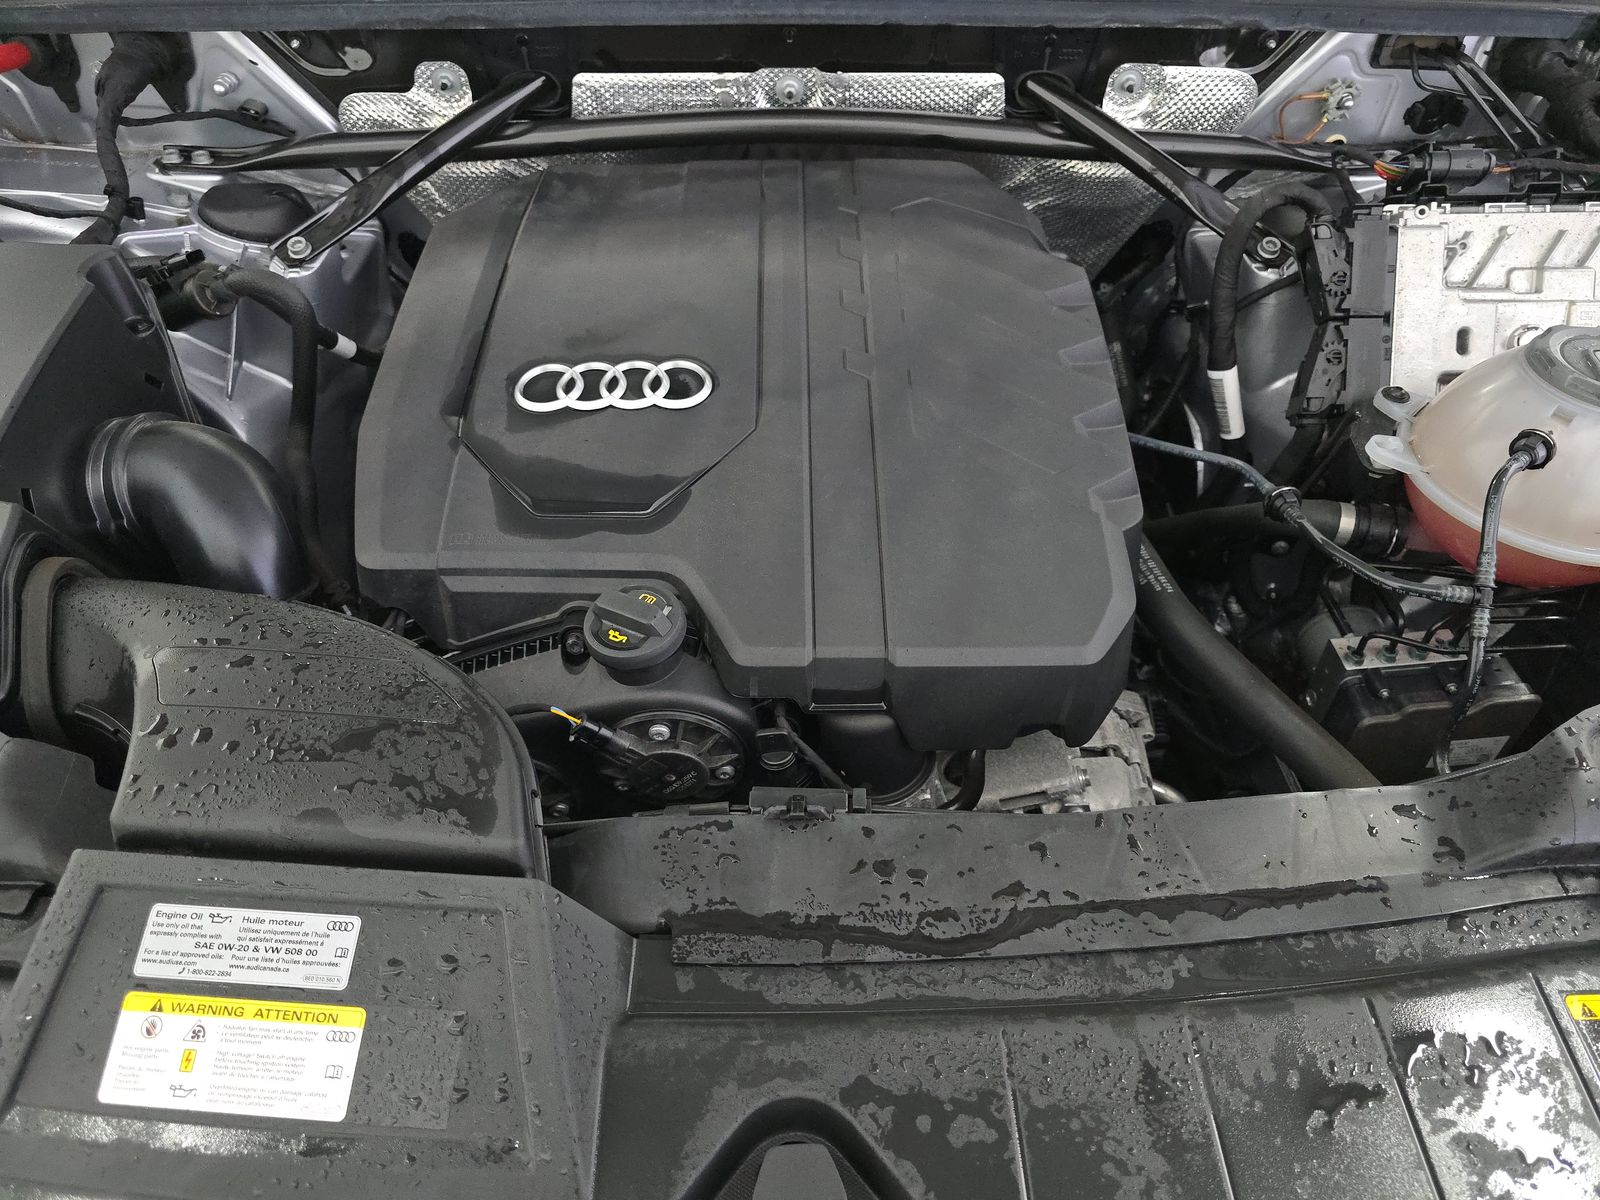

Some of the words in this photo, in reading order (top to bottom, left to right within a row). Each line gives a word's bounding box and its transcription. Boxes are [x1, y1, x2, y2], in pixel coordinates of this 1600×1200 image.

[156, 910, 187, 920] Engine
[242, 916, 266, 924] Huile
[268, 919, 304, 927] moteur
[194, 941, 215, 950] SAE
[217, 943, 250, 952] 0W-20
[265, 946, 283, 954] VW
[285, 947, 303, 956] 508
[180, 951, 210, 960] approved
[142, 958, 198, 966] www.audiusa.com
[170, 1001, 245, 1017] WARNING
[253, 1008, 339, 1024] ATTENTION
